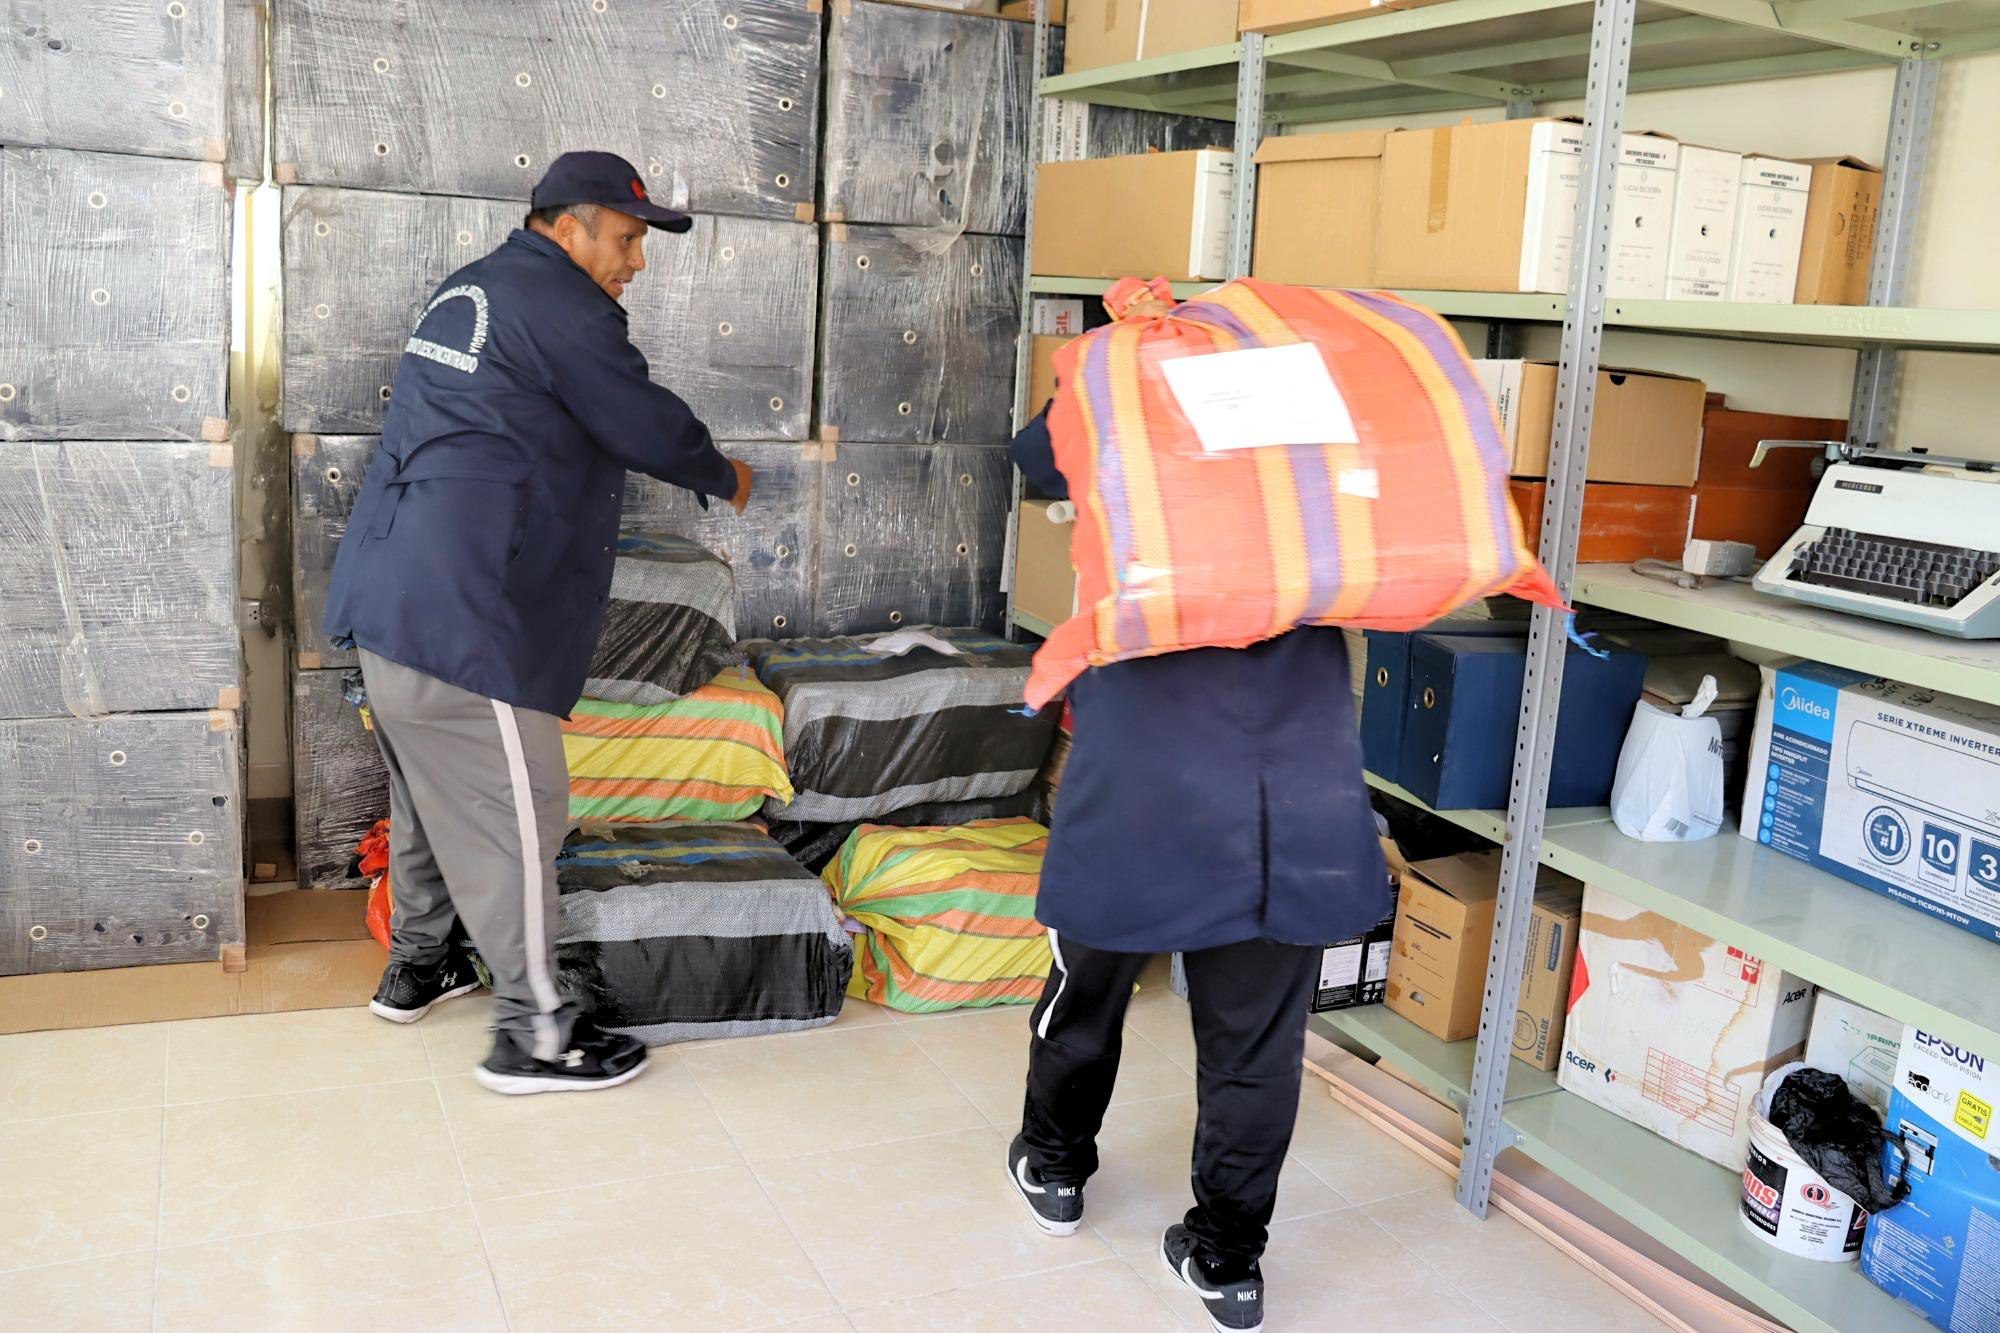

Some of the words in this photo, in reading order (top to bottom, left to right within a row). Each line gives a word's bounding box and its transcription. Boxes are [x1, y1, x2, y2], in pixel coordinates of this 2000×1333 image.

[1781, 686, 1830, 720] Midea
[1877, 712, 1904, 727] SERIE
[1906, 720, 1947, 741] XTREME
[1950, 734, 2000, 757] INVERTER
[1925, 833, 1956, 865] 10
[1978, 853, 1998, 881] 3
[1913, 1042, 1939, 1060] EXCEED
[1940, 1055, 1958, 1069] YOUR
[1958, 1066, 1983, 1082] VISION
[1915, 1029, 1985, 1073] EPSON
[1908, 1074, 1952, 1105] ecotank
[1961, 1096, 1988, 1117] GRATIS
[1057, 1186, 1076, 1197] NIKE
[1236, 1290, 1257, 1301] NIKE
